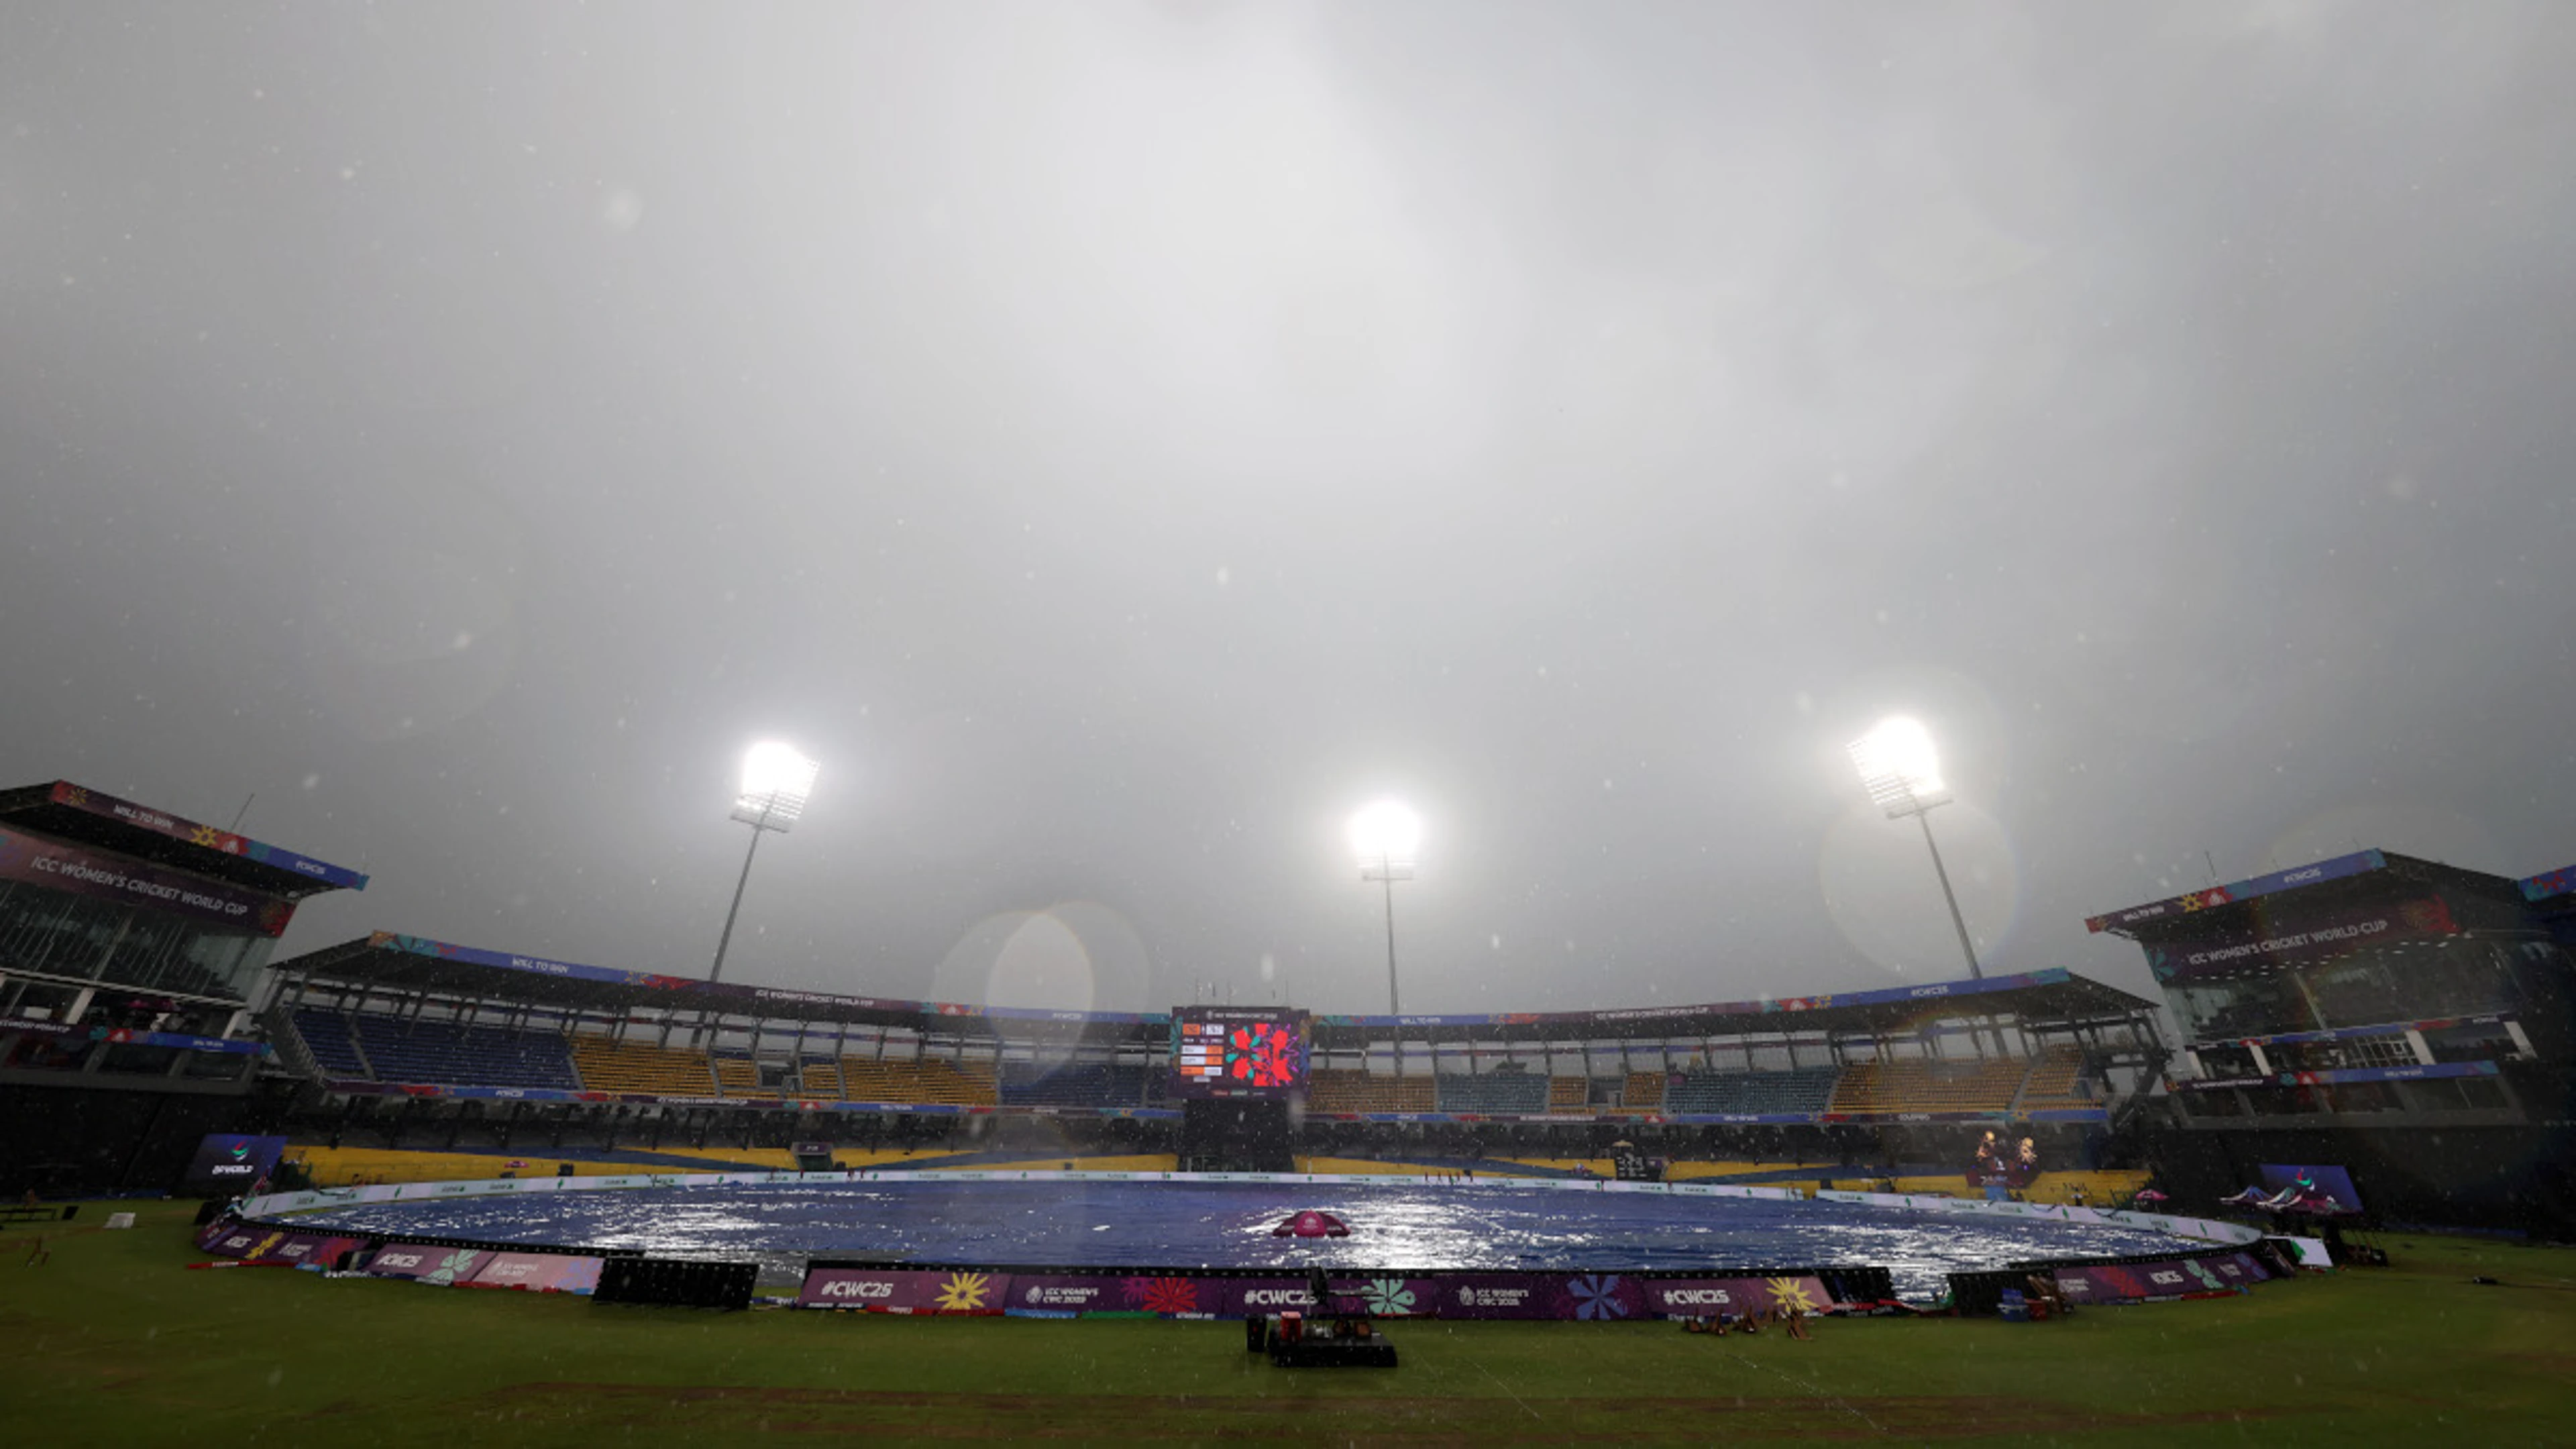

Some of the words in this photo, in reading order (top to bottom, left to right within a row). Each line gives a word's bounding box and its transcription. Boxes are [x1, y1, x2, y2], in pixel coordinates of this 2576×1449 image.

[31, 856, 58, 872] ICC
[60, 861, 127, 888] WOMEN'S
[127, 879, 181, 900] CRICKET
[180, 891, 225, 911] WORLD
[225, 902, 249, 916] CUP
[2188, 953, 2207, 965] ICC
[2208, 943, 2260, 961] WOMEN'S
[2260, 934, 2309, 952] CRICKET
[2310, 925, 2358, 943] WORLD
[2359, 919, 2389, 934] CUP
[820, 1280, 894, 1299] #CWC25
[1044, 1287, 1060, 1295] ICC
[1244, 1289, 1318, 1305] #CWC25
[1477, 1288, 1491, 1297] ICC
[1663, 1289, 1730, 1306] #CWC25
[1042, 1295, 1063, 1303] CWC
[1477, 1297, 1497, 1306] CWC
